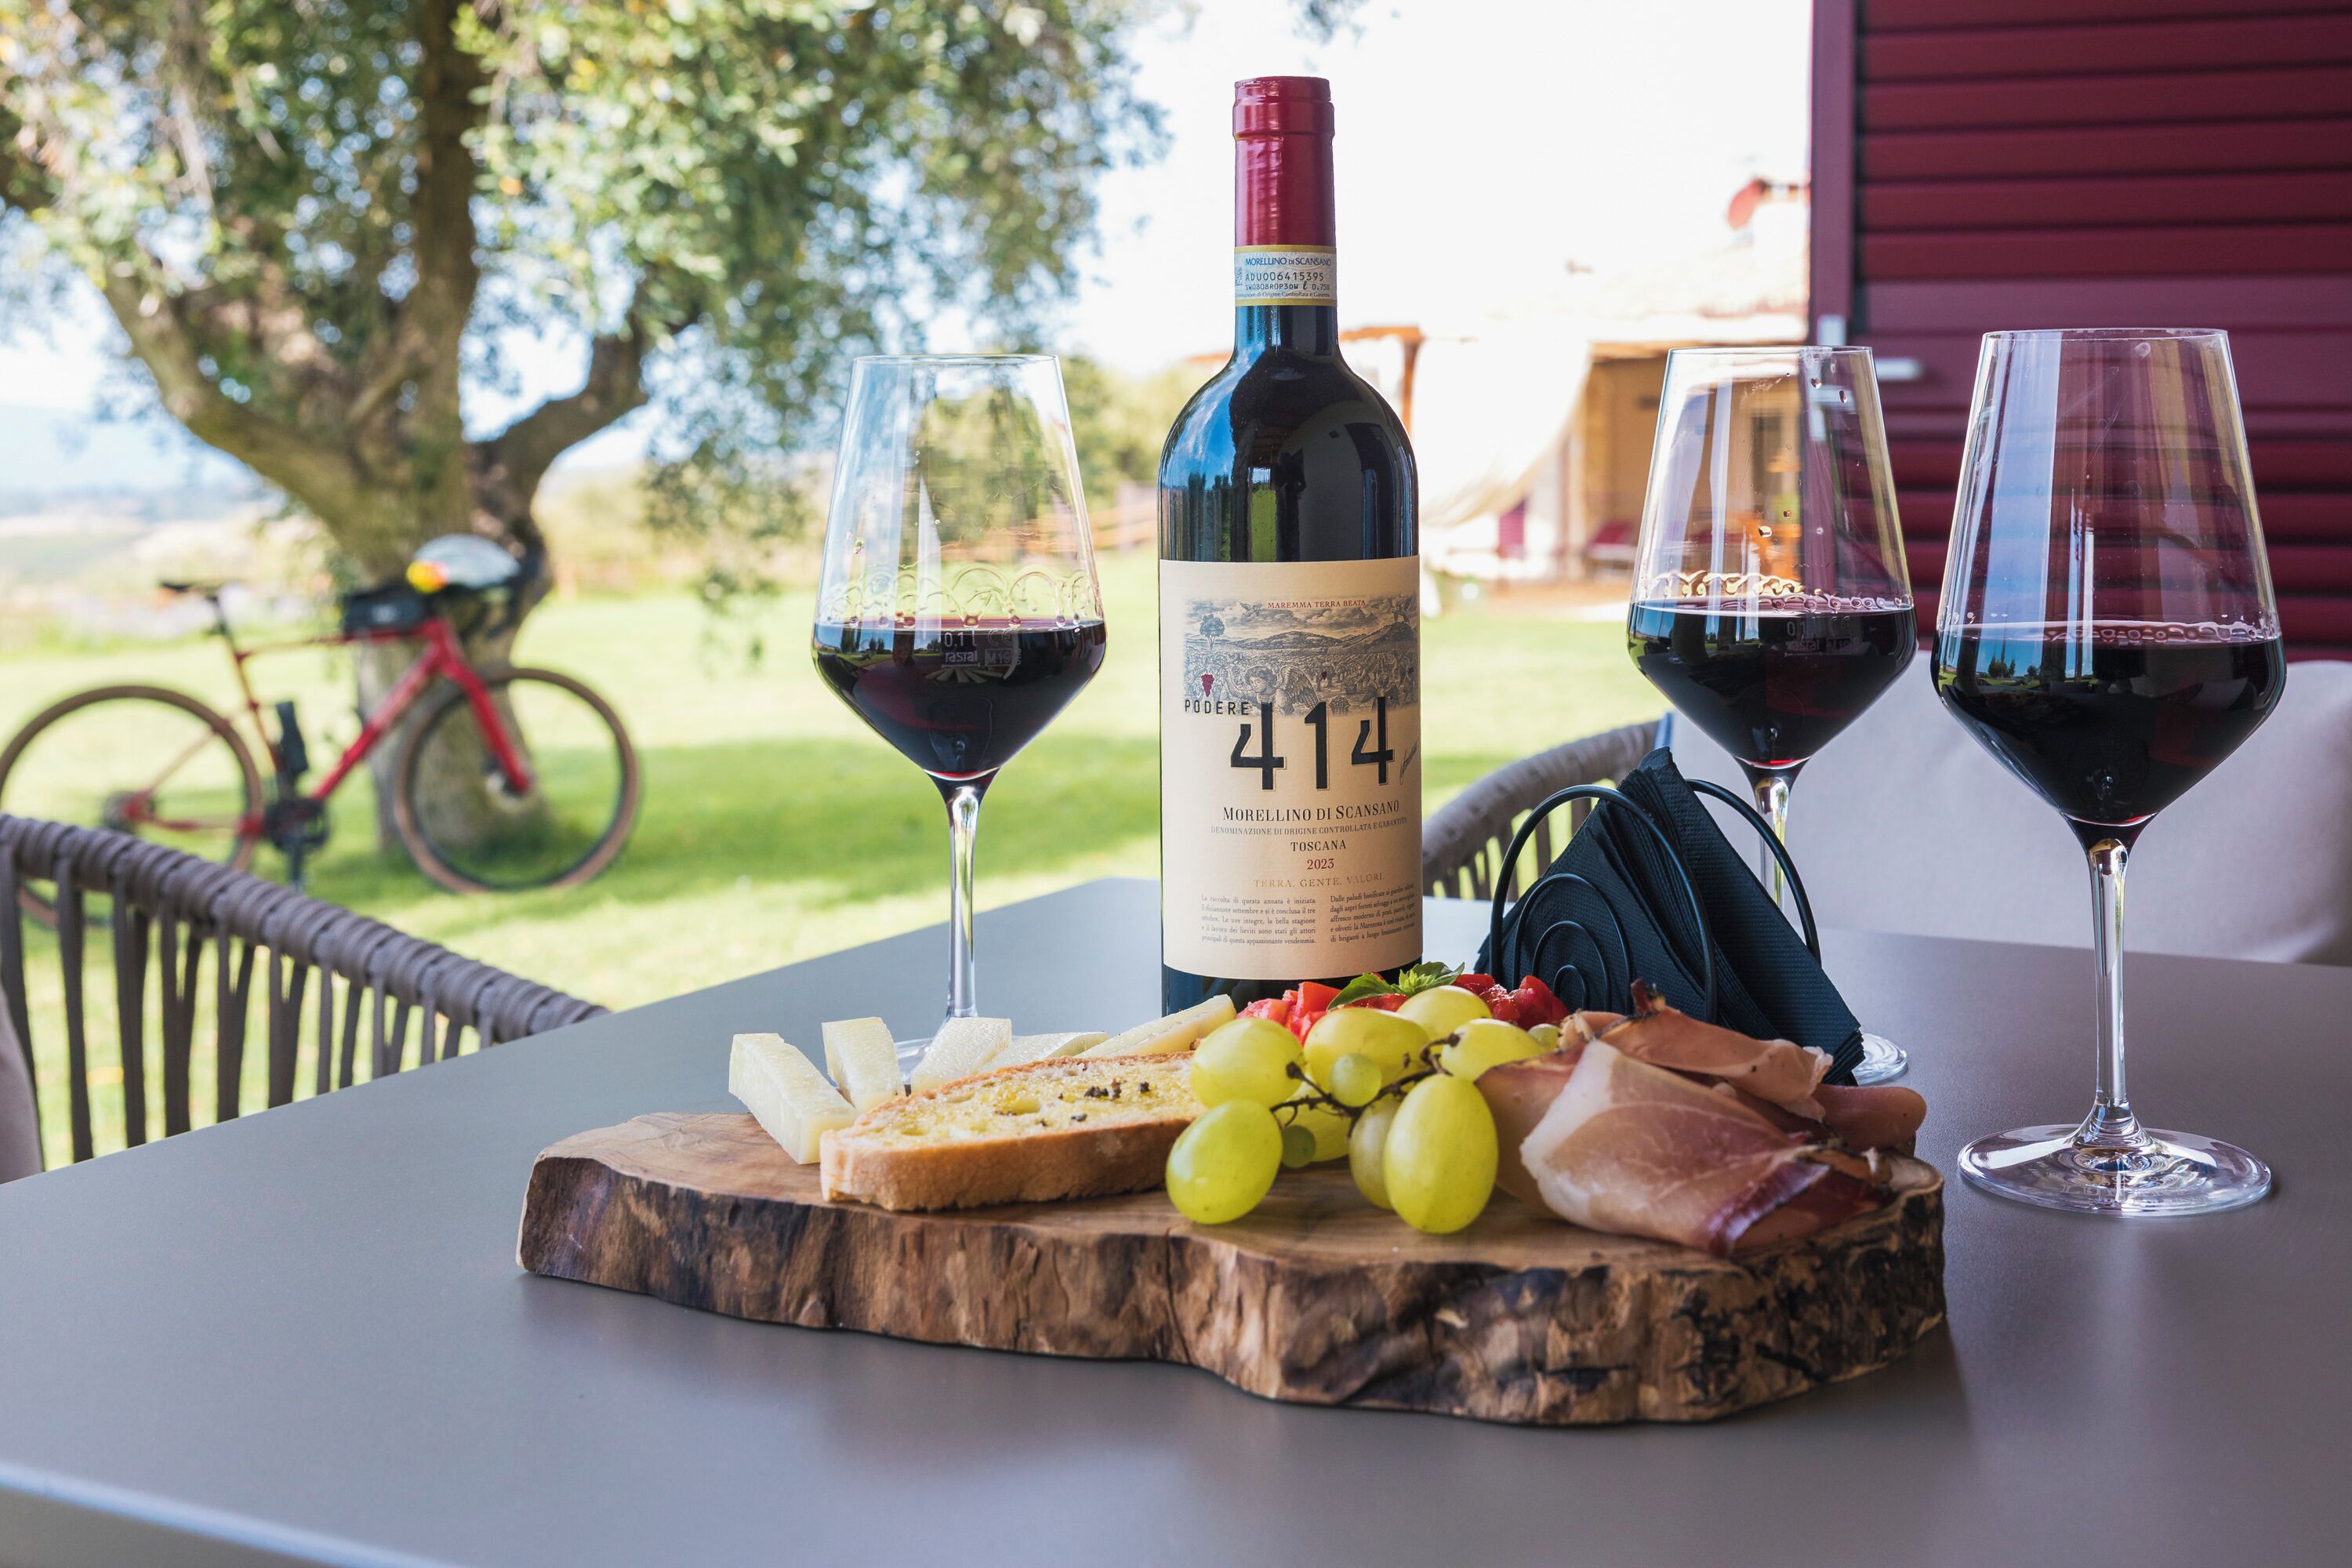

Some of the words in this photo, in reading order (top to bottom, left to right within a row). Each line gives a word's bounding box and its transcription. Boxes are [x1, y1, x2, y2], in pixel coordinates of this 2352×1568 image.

[1245, 257, 1287, 266] MORELLINO
[1295, 257, 1331, 267] SCANSANO
[1245, 272, 1324, 281] ADU006415395
[1185, 699, 1250, 716] PODERE
[1231, 696, 1394, 791] 414
[1223, 807, 1312, 821] MORELLINO
[1316, 808, 1330, 820] DI
[1336, 800, 1399, 819] SCANSANO
[1211, 826, 1272, 835] DENOMINAZIONE
[1319, 823, 1371, 834] CONTROLLATA
[1378, 816, 1407, 829] GARANTITA
[1290, 840, 1347, 852] TOSCANA
[1307, 858, 1334, 870] 2023
[1254, 879, 1295, 888] TERRA.
[1300, 877, 1342, 887] GENTE.
[1346, 894, 1363, 902] paludi
[1353, 912, 1374, 920] moderno
[1338, 934, 1359, 942] briganti
